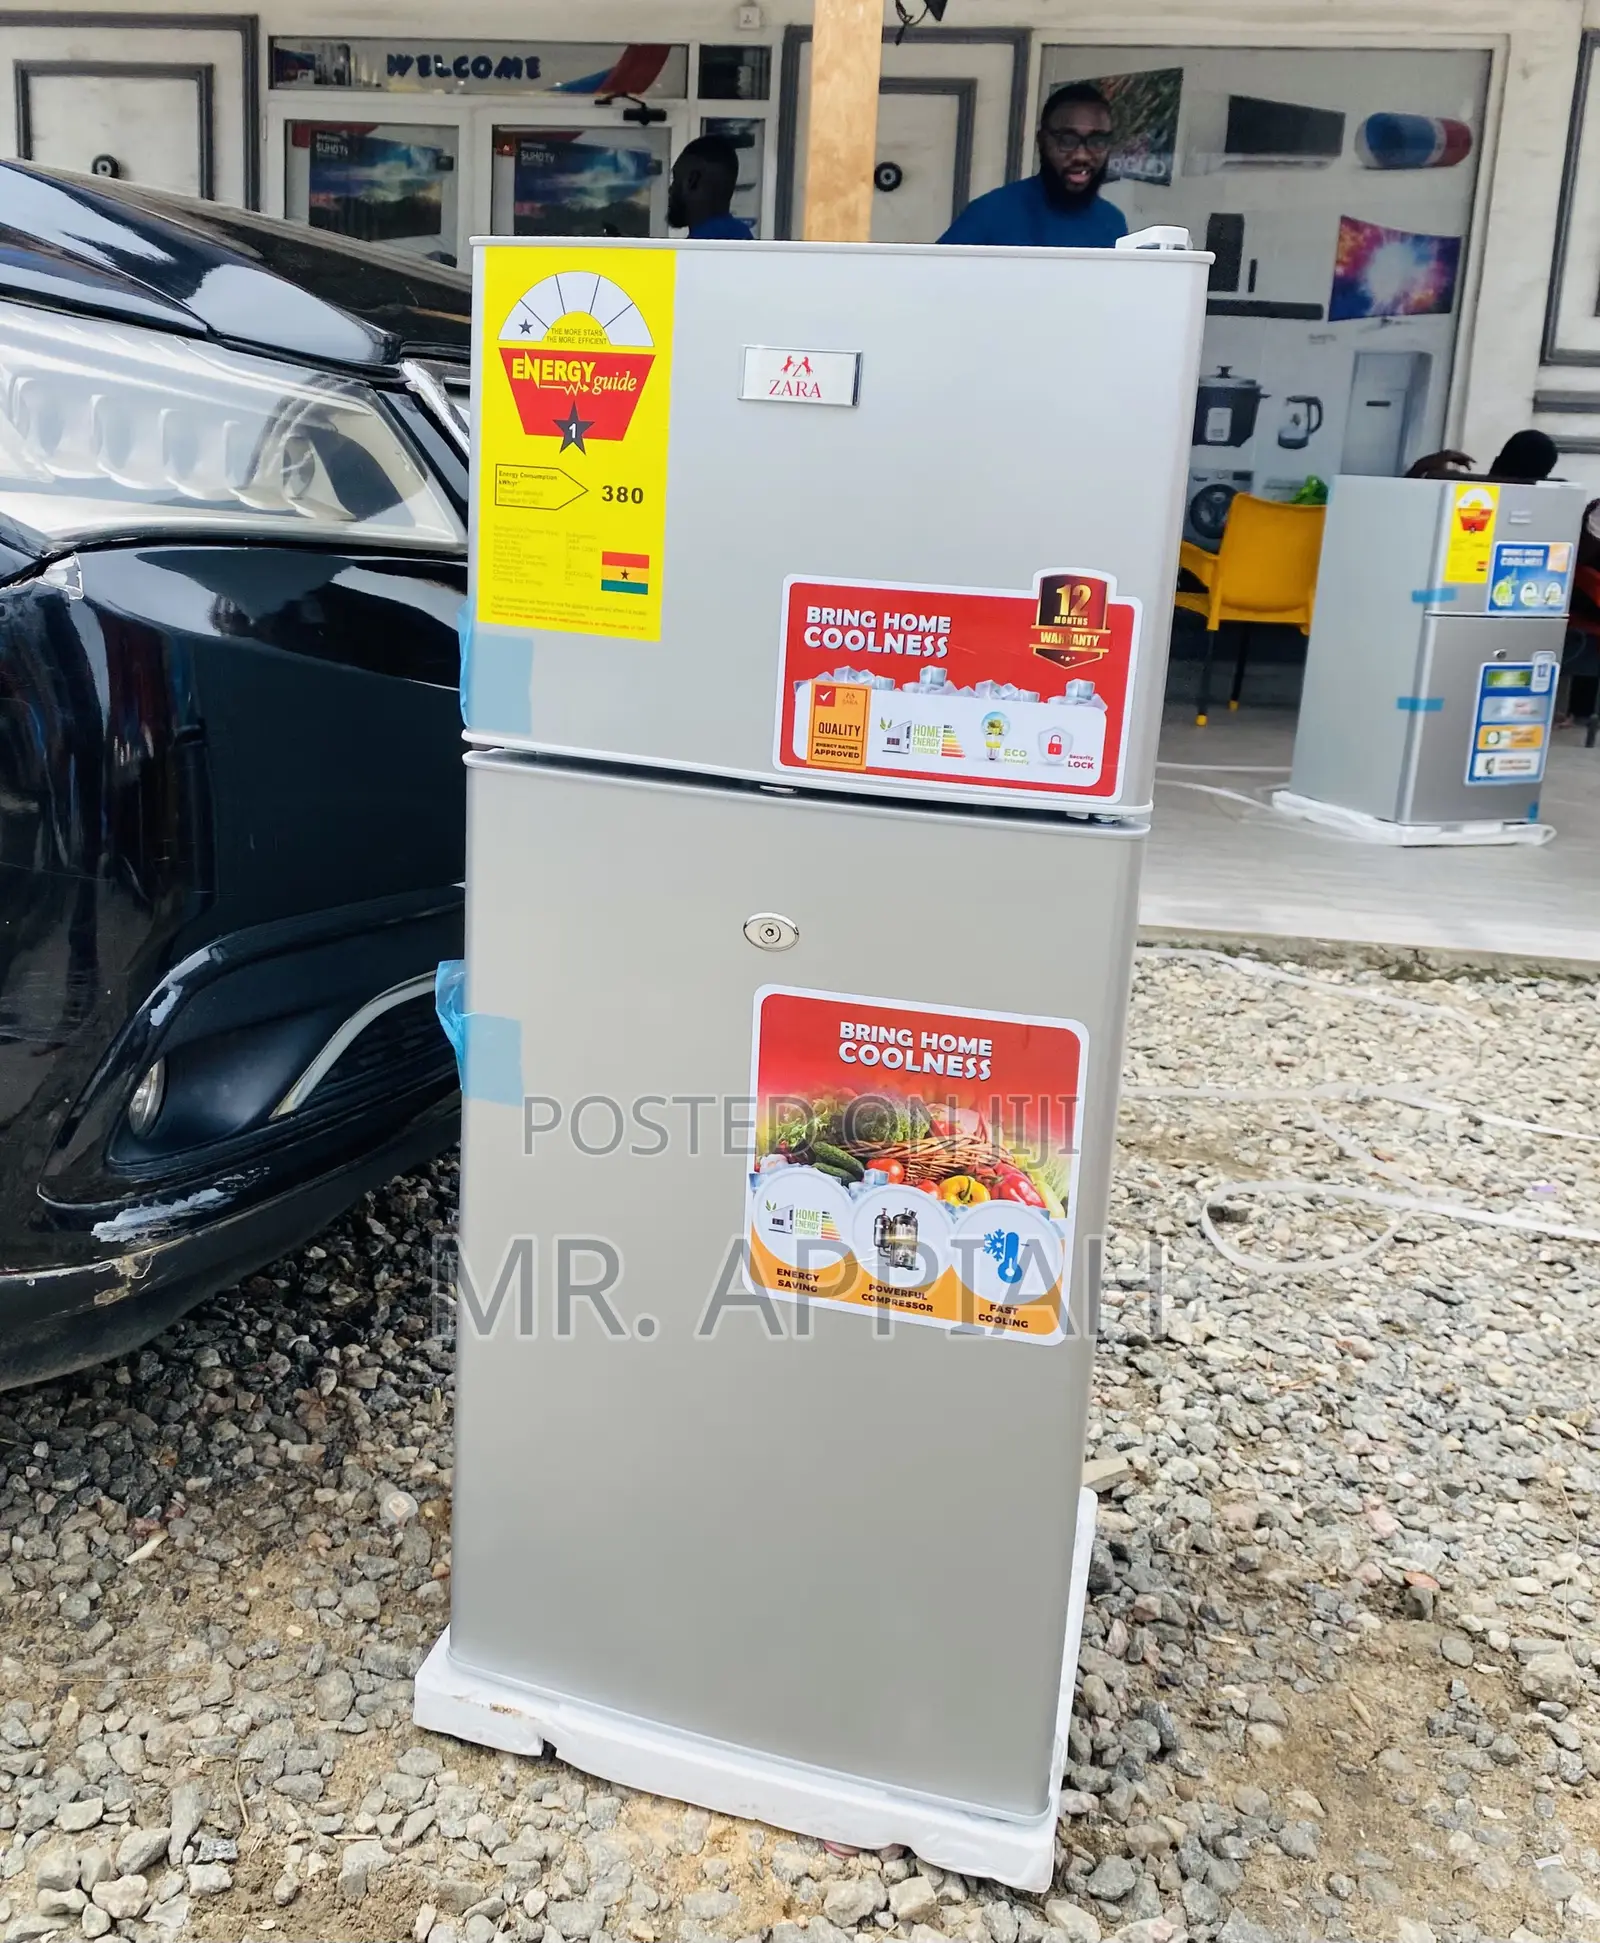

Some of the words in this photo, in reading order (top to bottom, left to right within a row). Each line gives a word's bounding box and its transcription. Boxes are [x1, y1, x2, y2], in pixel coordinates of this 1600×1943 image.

[387, 54, 541, 79] WELCOME
[551, 327, 562, 335] THE
[564, 328, 581, 336] MORE
[583, 329, 603, 337] STARS
[546, 335, 557, 343] THE
[558, 336, 576, 344] MORE
[578, 337, 607, 345] EFFICIENT
[512, 352, 596, 389] ENERGY
[592, 371, 637, 395] guide
[769, 379, 822, 399] ZARA
[569, 423, 577, 438] 1
[601, 485, 644, 504] 380
[1056, 584, 1092, 616] 12
[806, 606, 877, 629] BRING
[883, 612, 952, 635] HOME
[1054, 616, 1089, 626] MONTHS
[804, 626, 949, 658] COOLNESS
[1040, 631, 1100, 647] WARRANTY
[818, 722, 861, 737] QUALITY
[913, 723, 941, 738] HOME
[912, 736, 940, 748] ENERGY
[814, 749, 860, 759] APPROVED
[1004, 748, 1027, 758] ECO
[1069, 754, 1094, 762] Security
[1067, 760, 1094, 770] LOCK
[840, 1021, 914, 1047] BRING
[921, 1032, 993, 1057] HOME
[839, 1042, 992, 1081] COOLNESS
[796, 1208, 820, 1222] HOME
[795, 1219, 819, 1230] ENERGY
[777, 1268, 819, 1282] ENERGY
[778, 1279, 818, 1292] SAVING
[869, 1284, 928, 1301] POWERFUL
[861, 1294, 934, 1312] COMPRESSOR
[990, 1303, 1019, 1315] FAST
[978, 1313, 1029, 1329] COOLING
